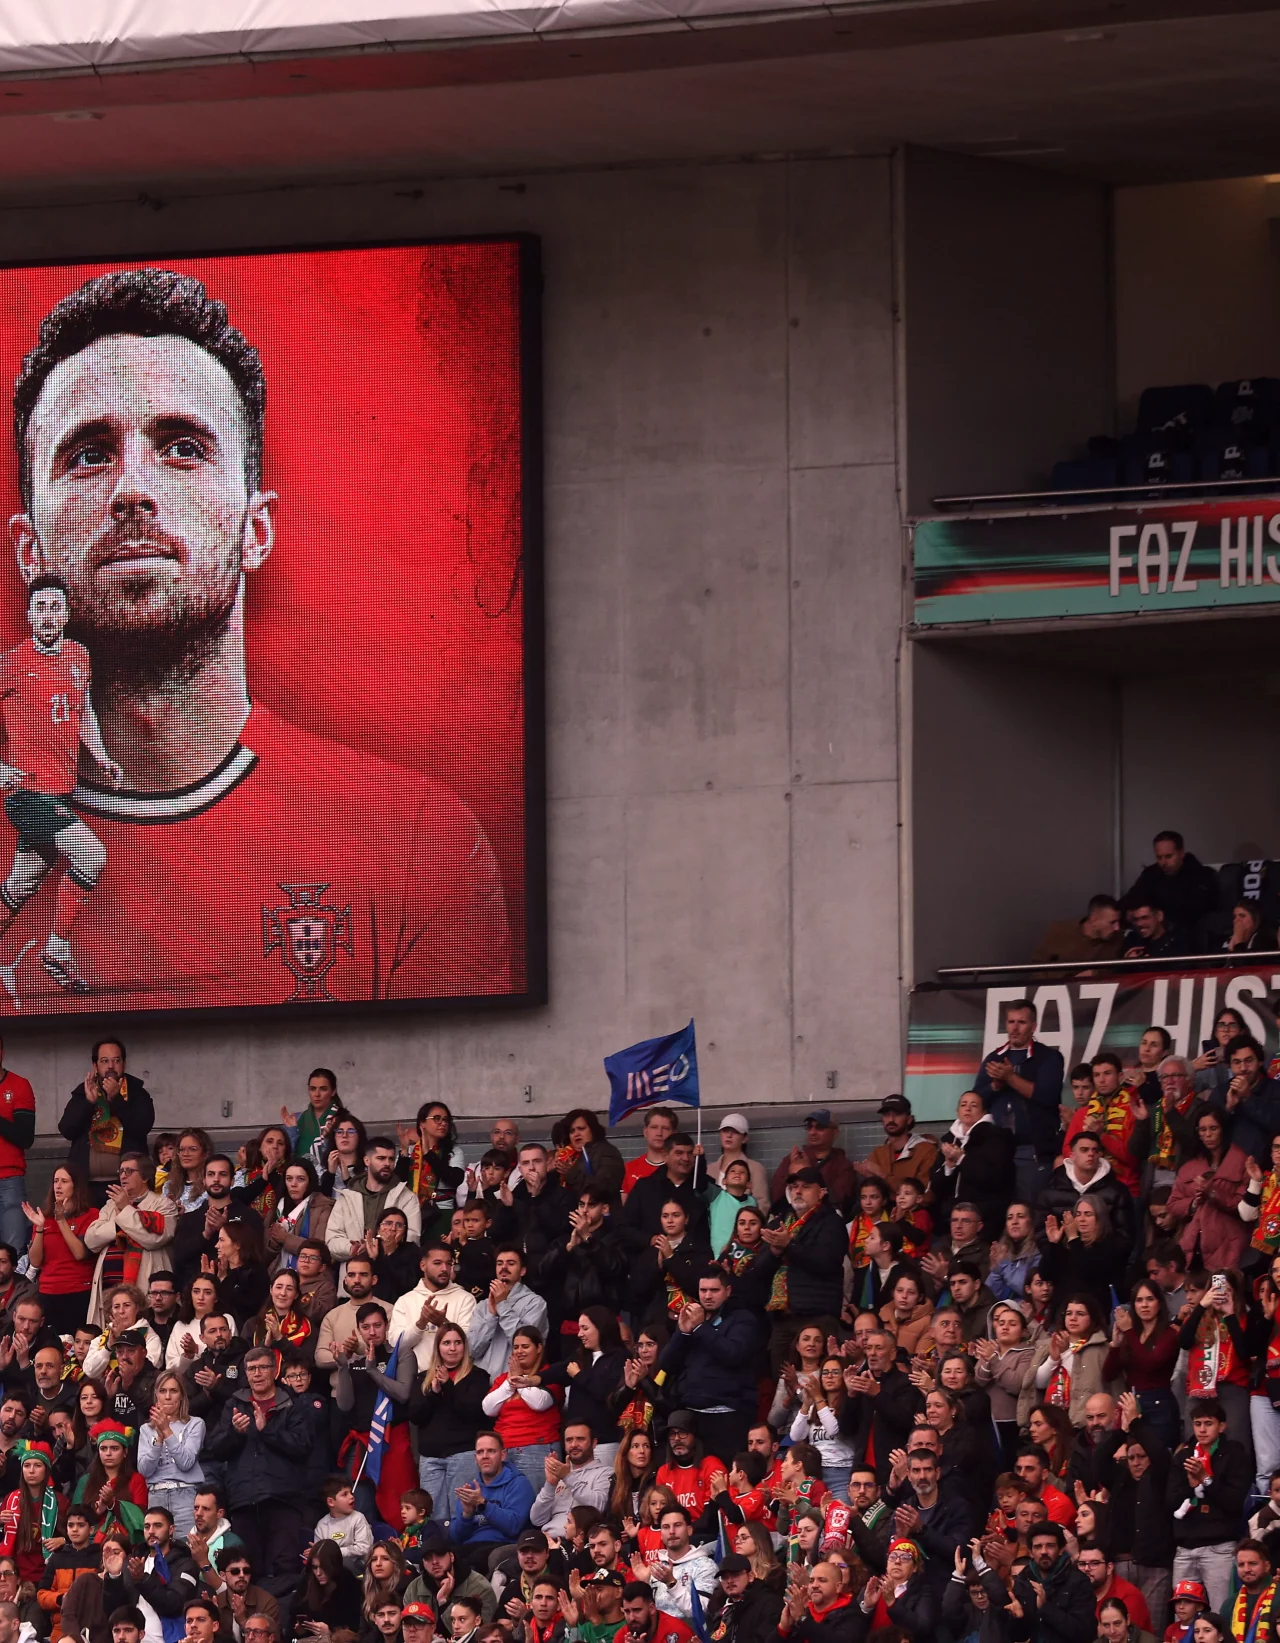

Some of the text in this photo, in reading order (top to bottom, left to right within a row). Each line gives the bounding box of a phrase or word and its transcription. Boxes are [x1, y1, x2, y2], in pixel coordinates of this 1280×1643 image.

[1109, 520, 1199, 597] FAZ
[982, 973, 1280, 1083] FAZ HIS
[626, 1053, 690, 1100] MEO
[645, 1548, 658, 1562] 202
